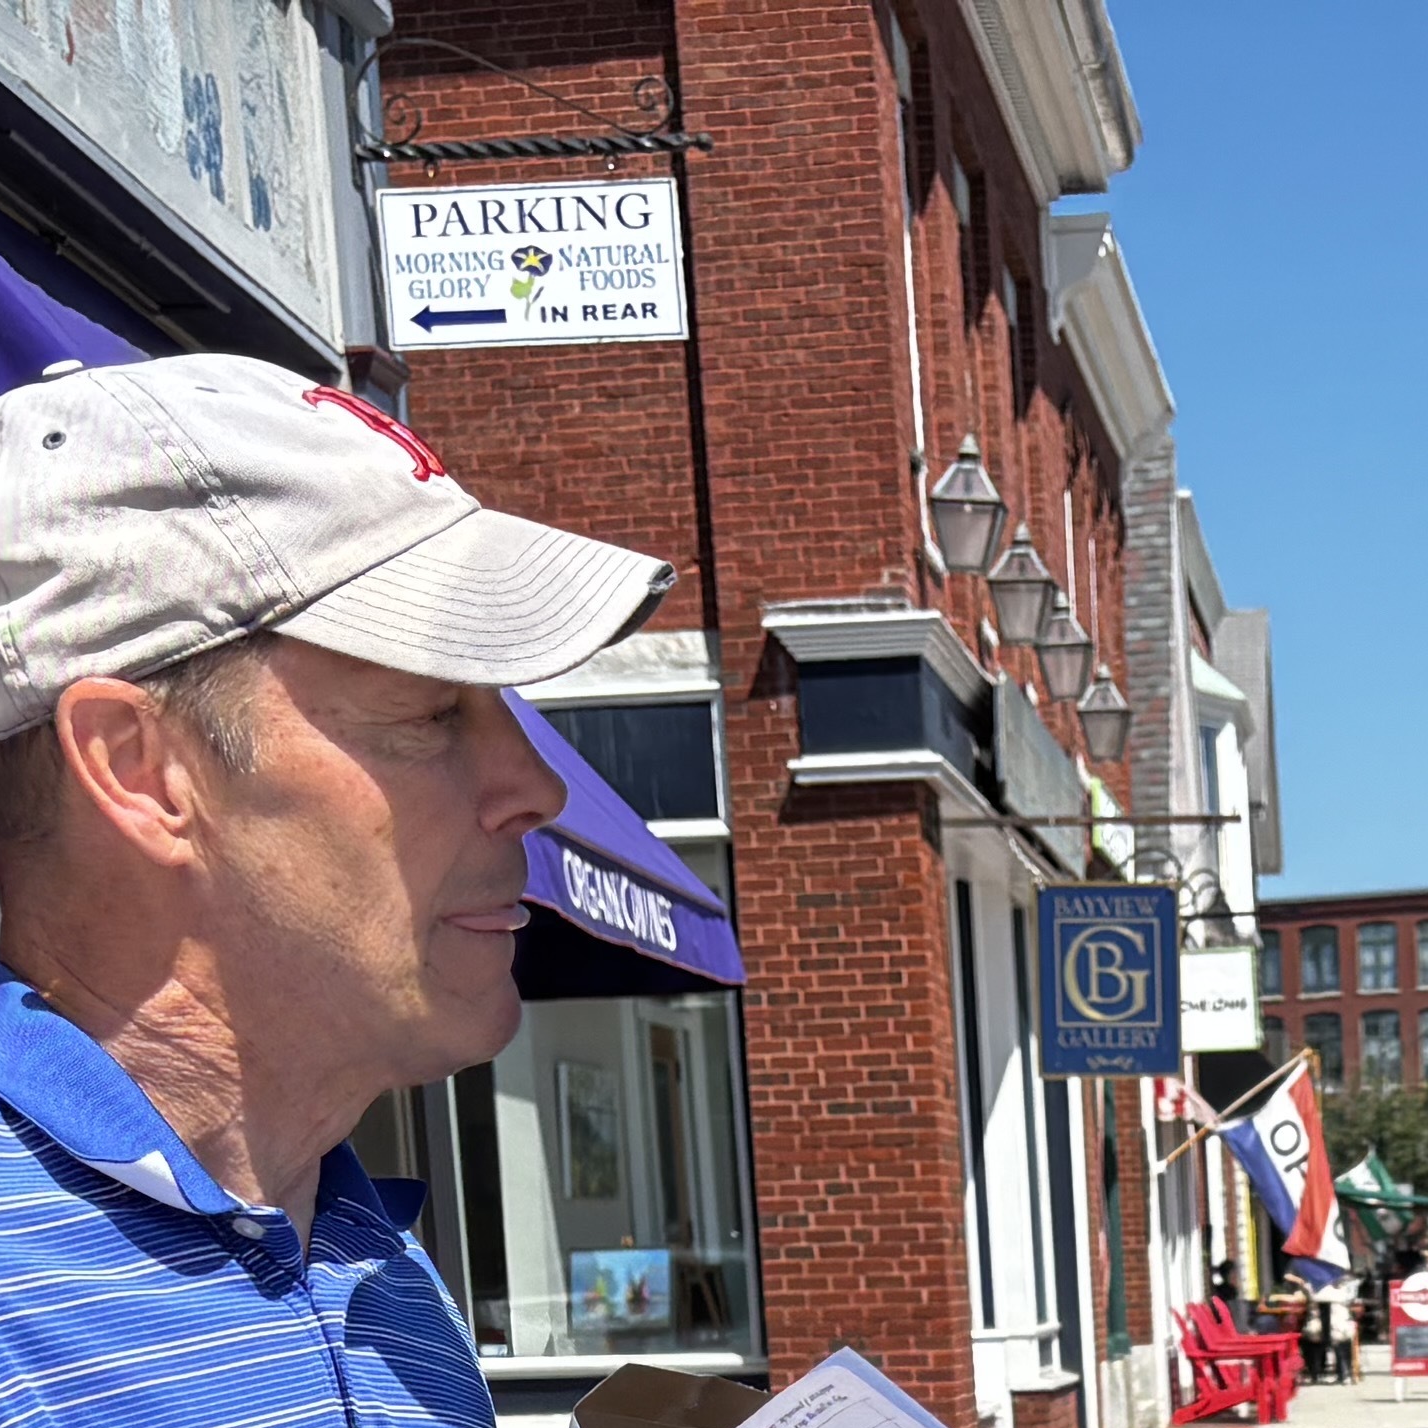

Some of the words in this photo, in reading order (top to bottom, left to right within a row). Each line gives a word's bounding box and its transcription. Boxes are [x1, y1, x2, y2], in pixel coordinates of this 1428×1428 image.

[411, 193, 653, 237] PARKING
[395, 251, 505, 276] MORNING
[558, 244, 670, 269] NATURAL
[409, 275, 491, 300] GLORY
[579, 268, 656, 291] FOODS
[540, 305, 569, 323] IN
[583, 302, 659, 321] REAR
[1054, 896, 1160, 916] BAYVIEW
